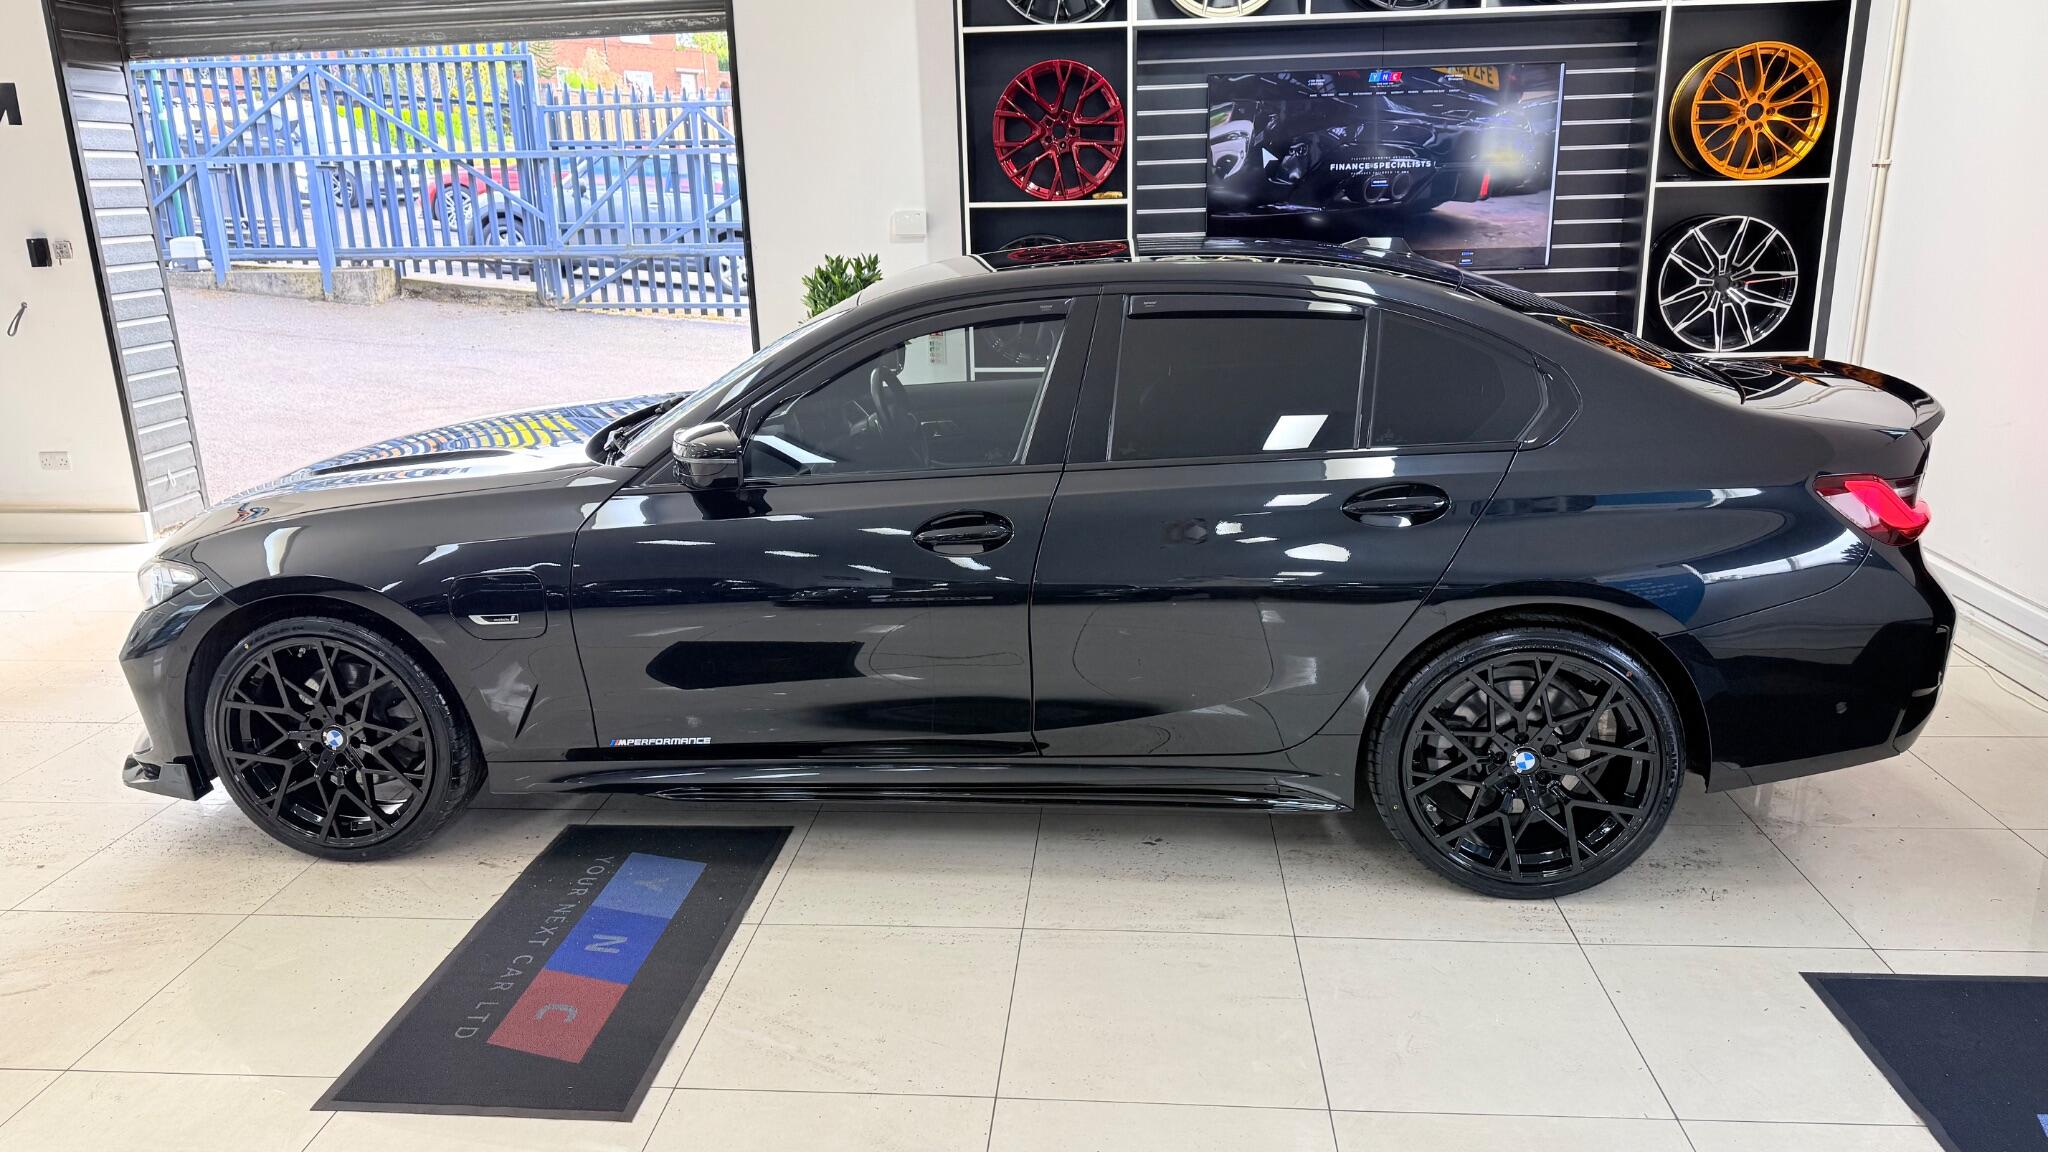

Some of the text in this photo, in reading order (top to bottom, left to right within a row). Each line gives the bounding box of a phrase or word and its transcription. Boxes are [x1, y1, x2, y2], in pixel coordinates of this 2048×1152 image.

[1330, 160, 1431, 171] FINANCE SPECIALISTS
[454, 856, 615, 1039] YOUR NEXT CAR LTD
